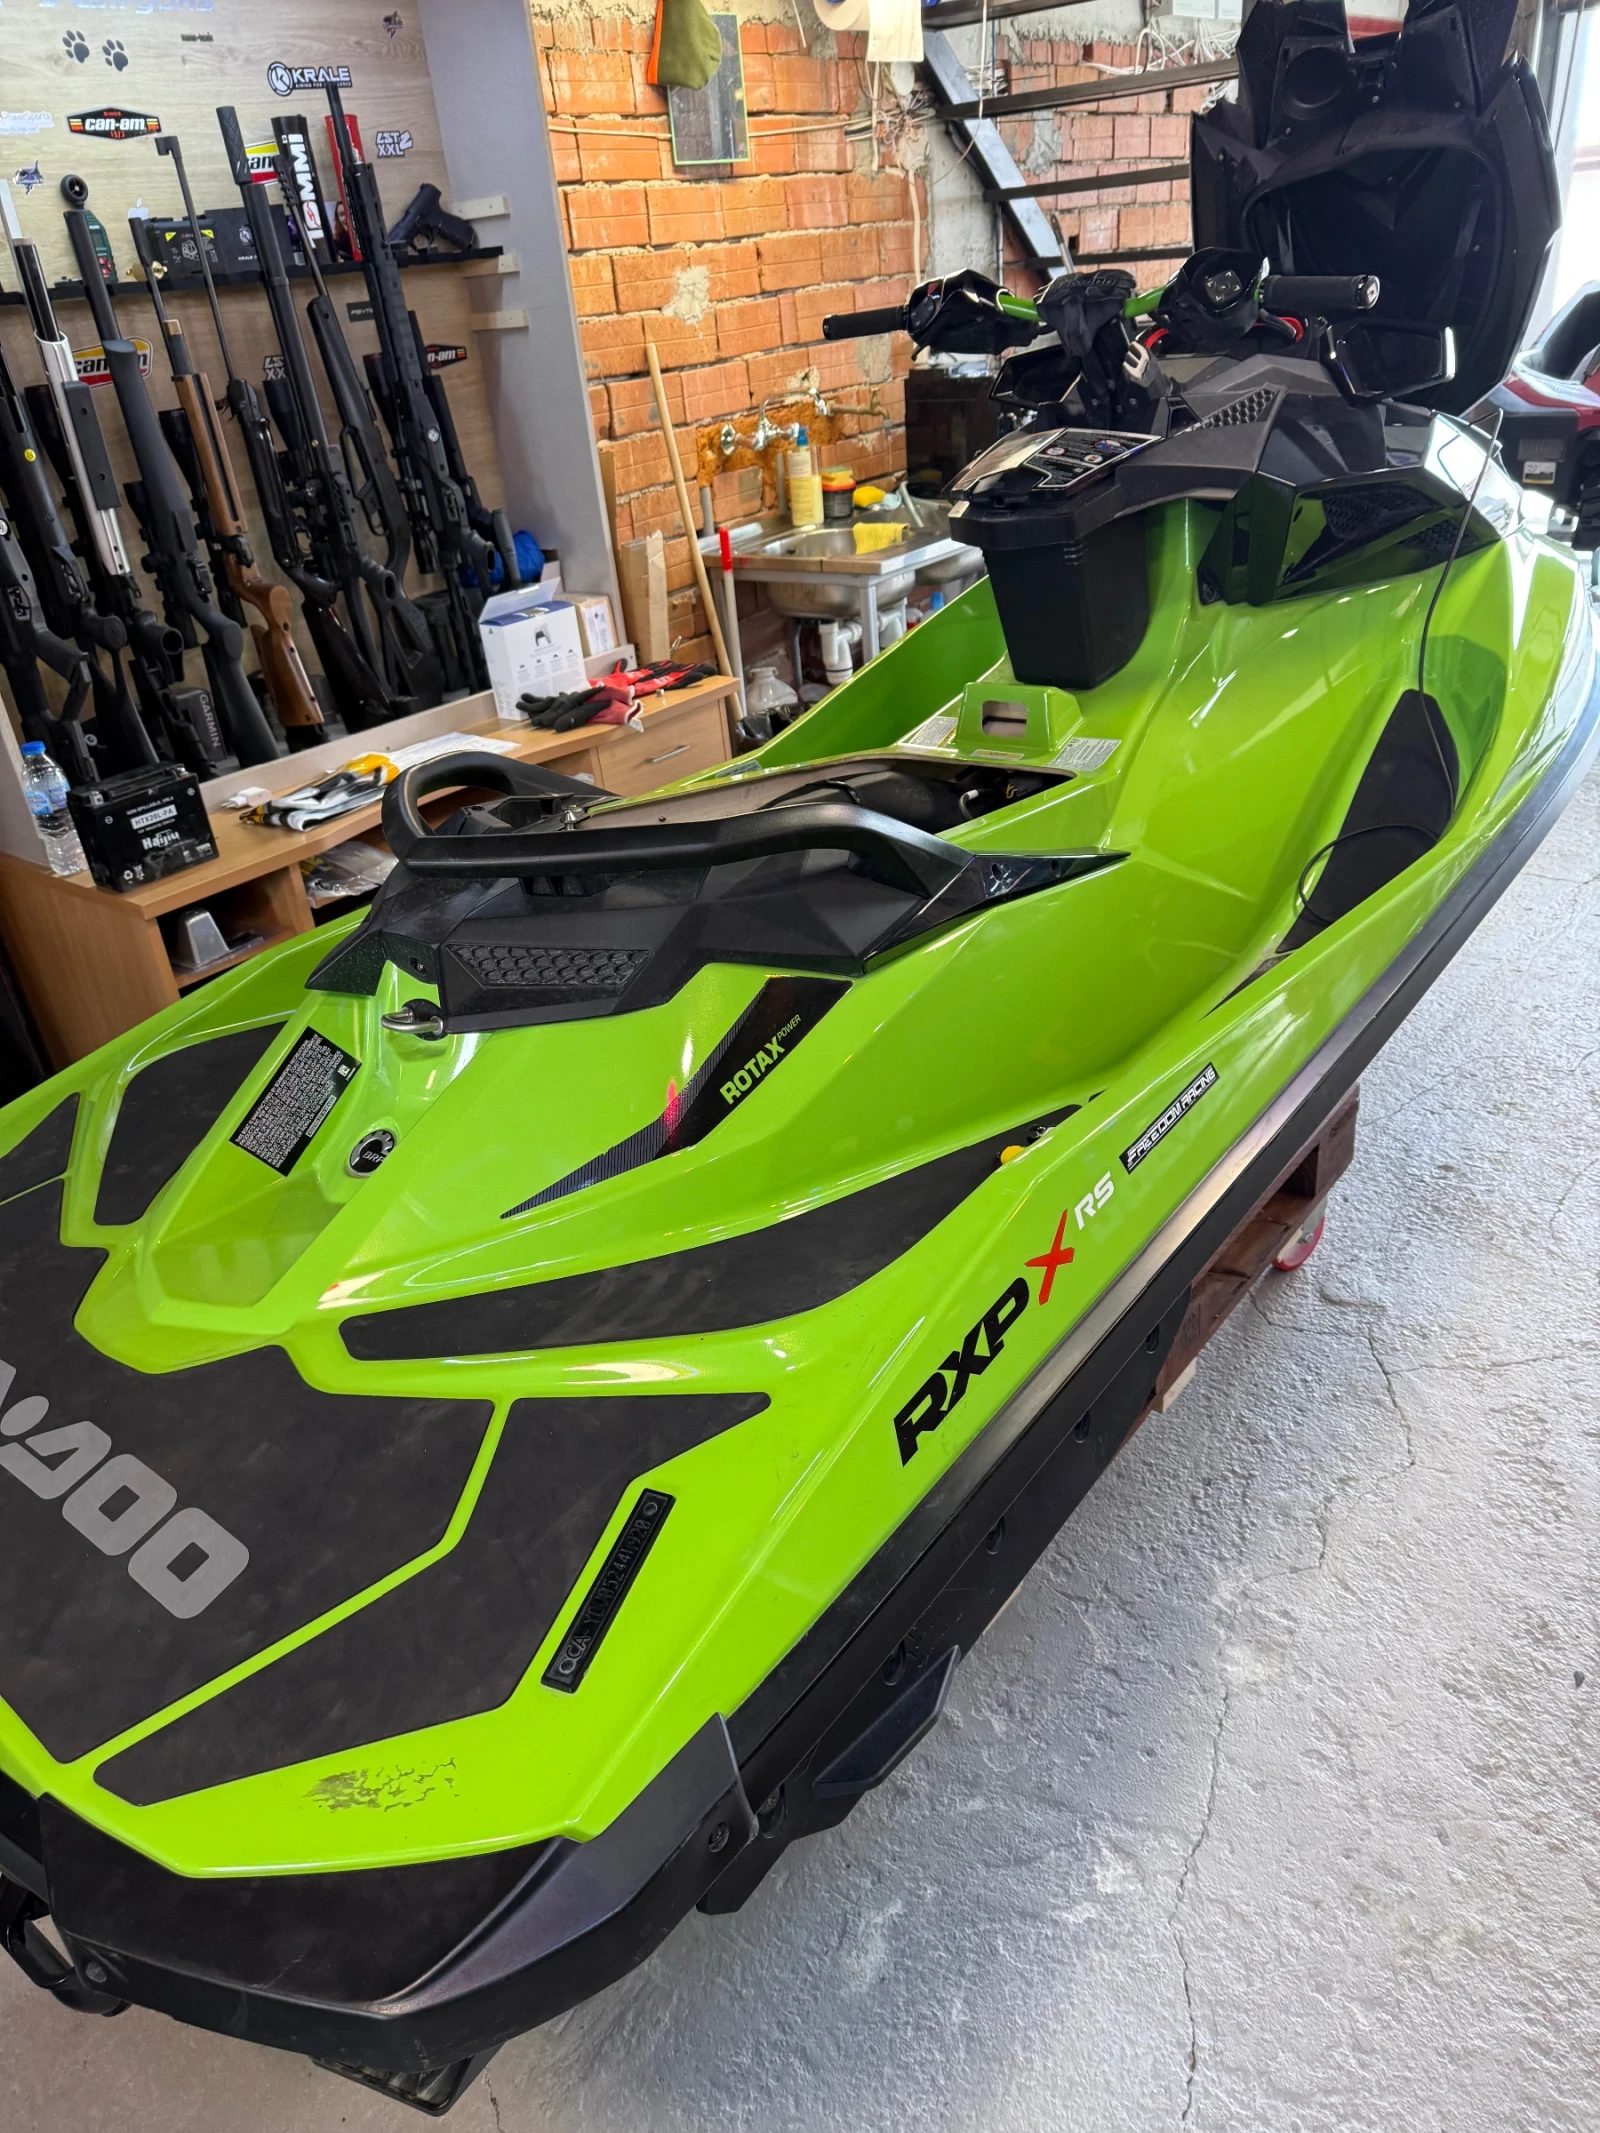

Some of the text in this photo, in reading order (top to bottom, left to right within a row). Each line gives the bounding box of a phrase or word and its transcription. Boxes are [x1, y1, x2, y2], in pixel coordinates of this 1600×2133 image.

[292, 67, 351, 83] KRALE
[200, 694, 221, 747] GARMIN
[142, 830, 180, 850] Haijiu
[719, 1014, 802, 1105] ROTAX POWER
[1127, 1102, 1182, 1167] FREEDOM
[1181, 1067, 1216, 1110] RACING
[1073, 1170, 1115, 1231] RS
